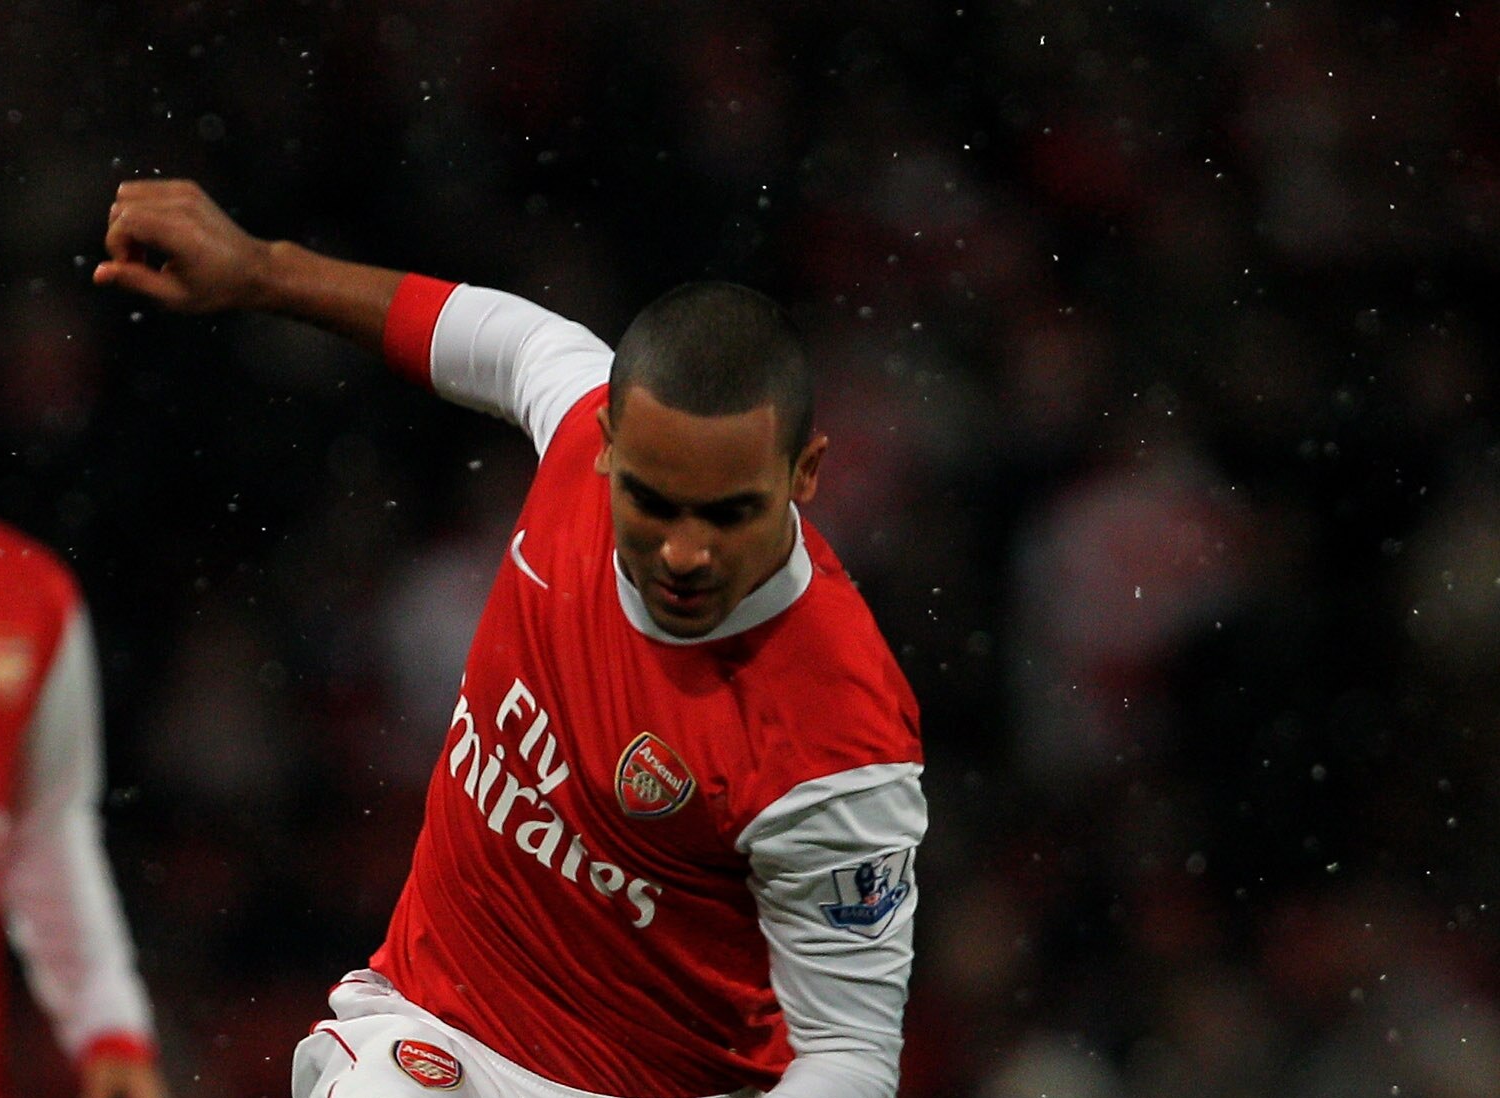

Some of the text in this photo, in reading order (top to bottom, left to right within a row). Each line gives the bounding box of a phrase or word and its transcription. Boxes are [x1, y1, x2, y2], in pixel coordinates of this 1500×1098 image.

[496, 677, 570, 795] Fly
[638, 745, 684, 792] Arsenal
[450, 672, 663, 929] mirates
